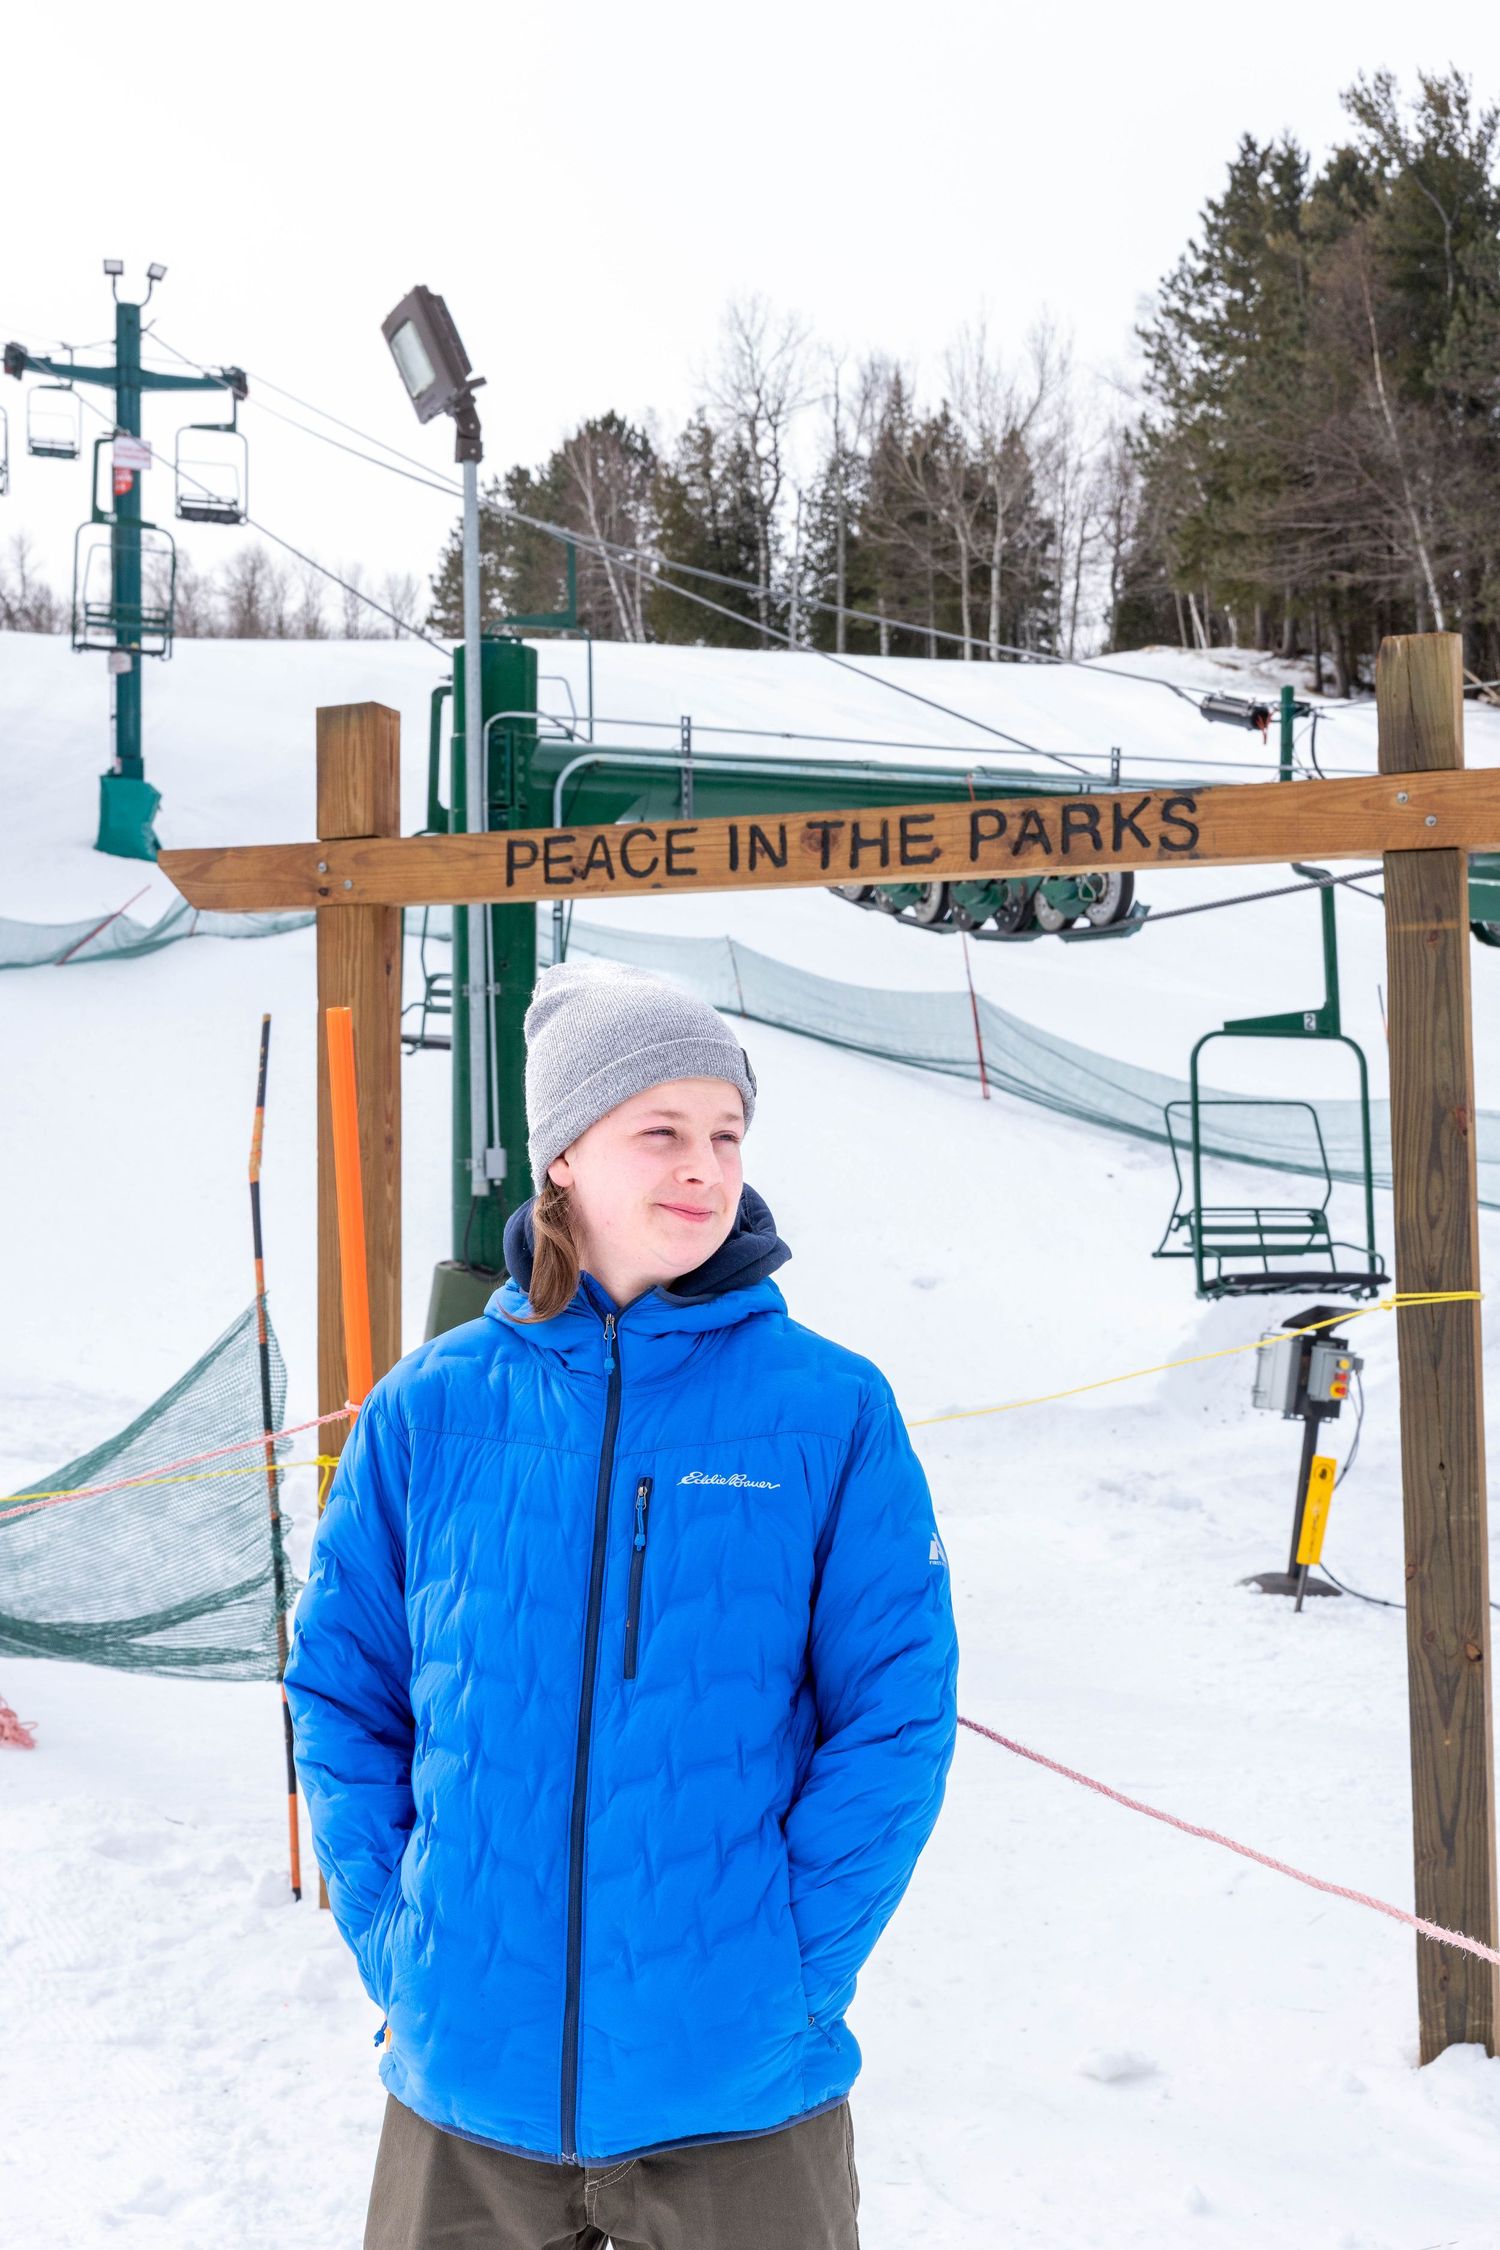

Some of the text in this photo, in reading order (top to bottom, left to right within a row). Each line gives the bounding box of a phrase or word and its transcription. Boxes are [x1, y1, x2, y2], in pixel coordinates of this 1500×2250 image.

[506, 796, 1199, 888] PEACE IN THE PARKS
[1305, 1014, 1314, 1030] 2
[676, 1471, 781, 1490] Eddie Bauer
